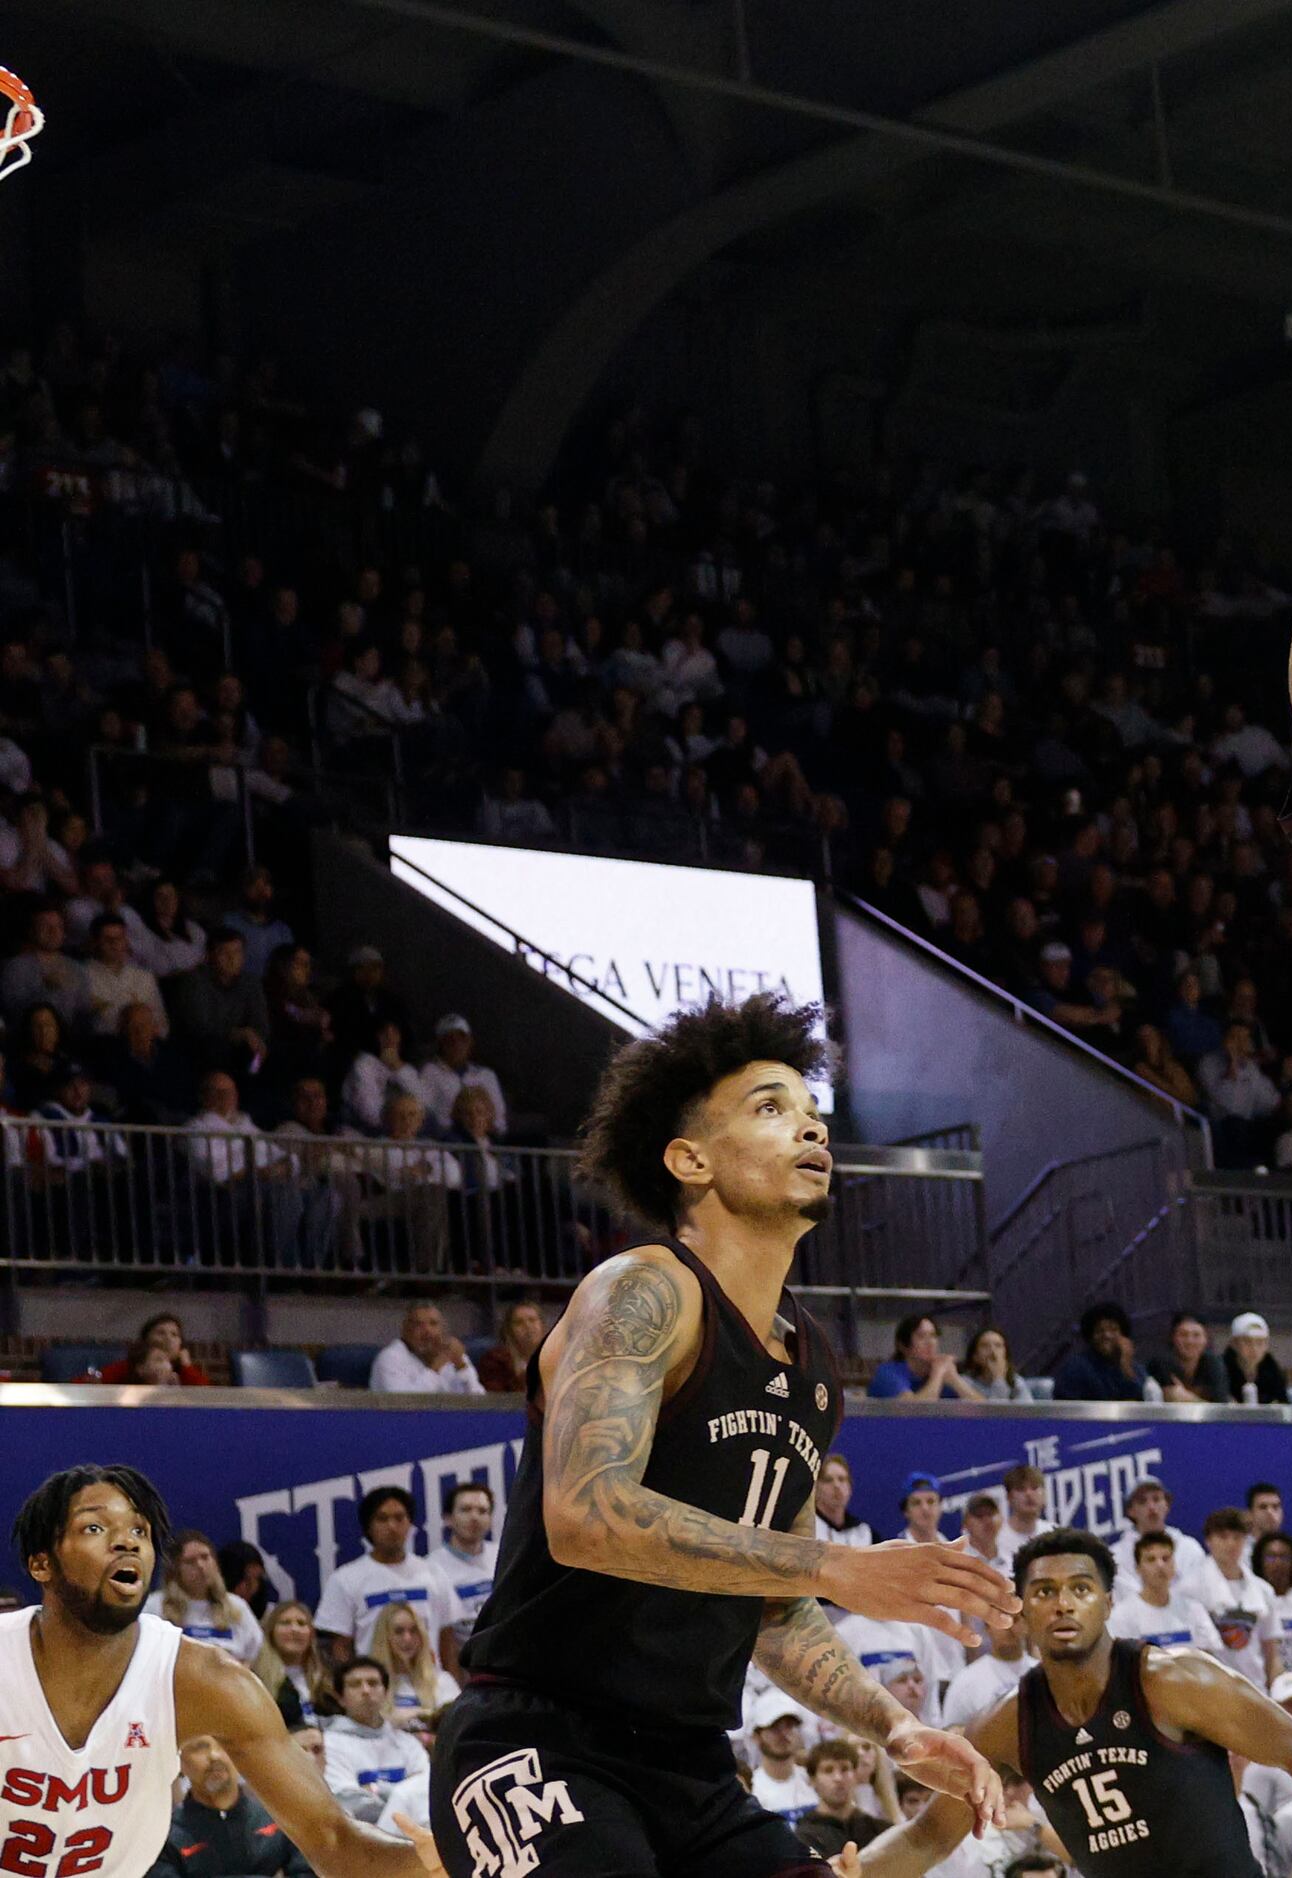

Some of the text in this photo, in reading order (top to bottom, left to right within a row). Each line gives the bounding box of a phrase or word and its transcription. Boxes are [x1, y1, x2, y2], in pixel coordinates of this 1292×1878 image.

[644, 959, 796, 1004] VENETA
[707, 1409, 783, 1443] FIGHTIN'
[738, 1448, 791, 1529] 11
[0, 1763, 132, 1812] SMU
[1042, 1746, 1150, 1795] FIGHTIN' TEXAS
[1071, 1768, 1133, 1829] 15
[0, 1819, 113, 1878] 22
[1088, 1818, 1151, 1854] AGGIES
